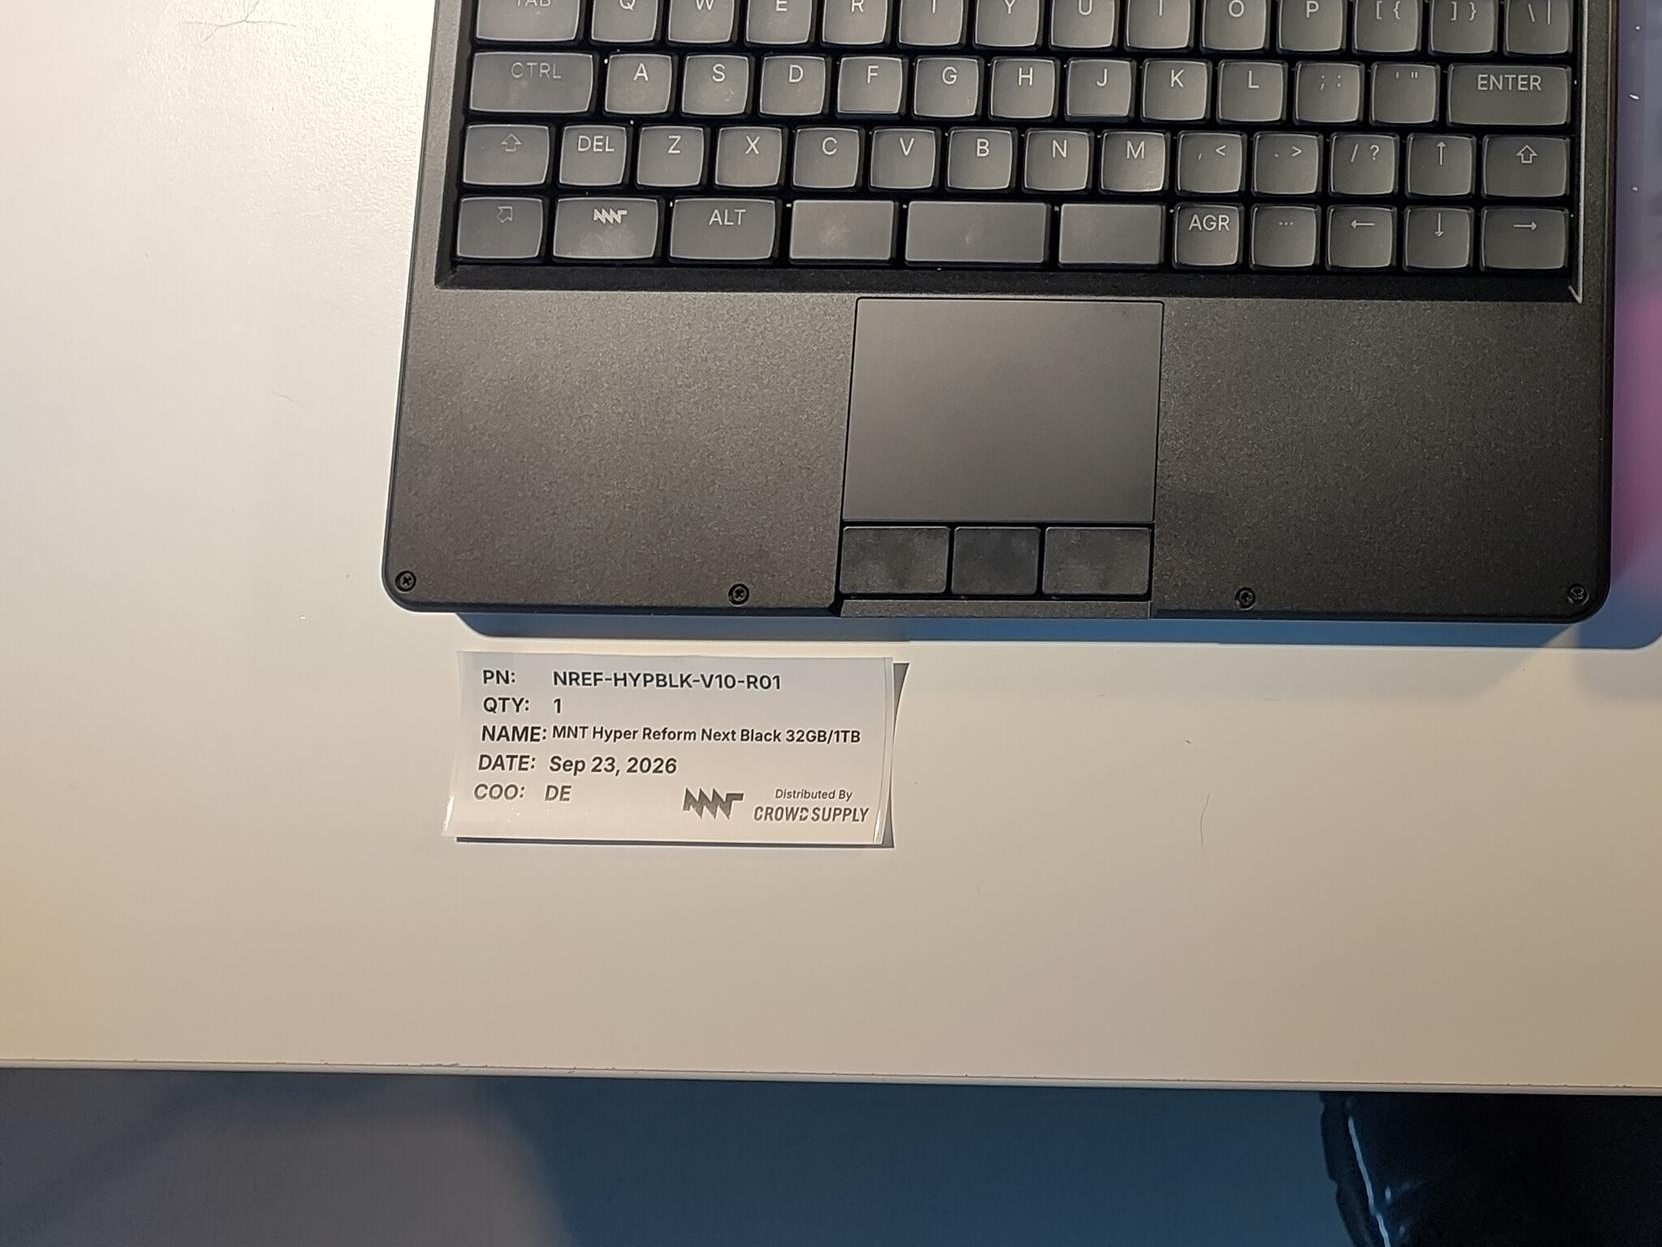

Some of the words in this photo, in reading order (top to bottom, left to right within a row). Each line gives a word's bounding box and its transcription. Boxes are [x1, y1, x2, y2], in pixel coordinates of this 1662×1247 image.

[1306, 1, 1319, 18] P
[511, 62, 561, 79] CTRL
[633, 64, 648, 82] A
[712, 64, 725, 82] S
[789, 65, 803, 82] D
[867, 66, 878, 83] F
[942, 67, 957, 85] G
[1019, 68, 1033, 86] H
[1096, 69, 1107, 87] J
[1170, 70, 1184, 87] K
[1248, 71, 1259, 89] L
[1478, 74, 1541, 91] ENTER
[578, 135, 614, 152] DEL
[668, 136, 681, 154] Z
[745, 137, 760, 154] X
[822, 137, 837, 156] C
[899, 138, 914, 156] V
[977, 139, 989, 156] B
[1052, 140, 1067, 157] N
[1126, 141, 1144, 159] M
[709, 209, 746, 226] ALT
[1189, 215, 1230, 232] AGR
[482, 670, 516, 685] PN:
[553, 671, 781, 690] NREF-HYPBLK-V10-R01
[483, 697, 530, 714] QTY:
[553, 698, 562, 713] 1
[482, 725, 547, 743] NAME:
[552, 726, 588, 739] MNT
[592, 726, 638, 743] Hyper
[642, 727, 696, 741] Reform
[701, 728, 736, 741] Next
[740, 728, 781, 743] Black
[785, 729, 860, 744] 32GB/1TB
[478, 754, 536, 772] DATE:
[549, 756, 585, 776] Sep
[590, 757, 621, 776] 23,
[627, 757, 677, 774] 2026
[474, 784, 525, 801] COO:
[545, 785, 572, 801] DE
[775, 789, 835, 799] Distributed
[839, 789, 852, 802] By
[811, 807, 869, 822] SUPPLY
